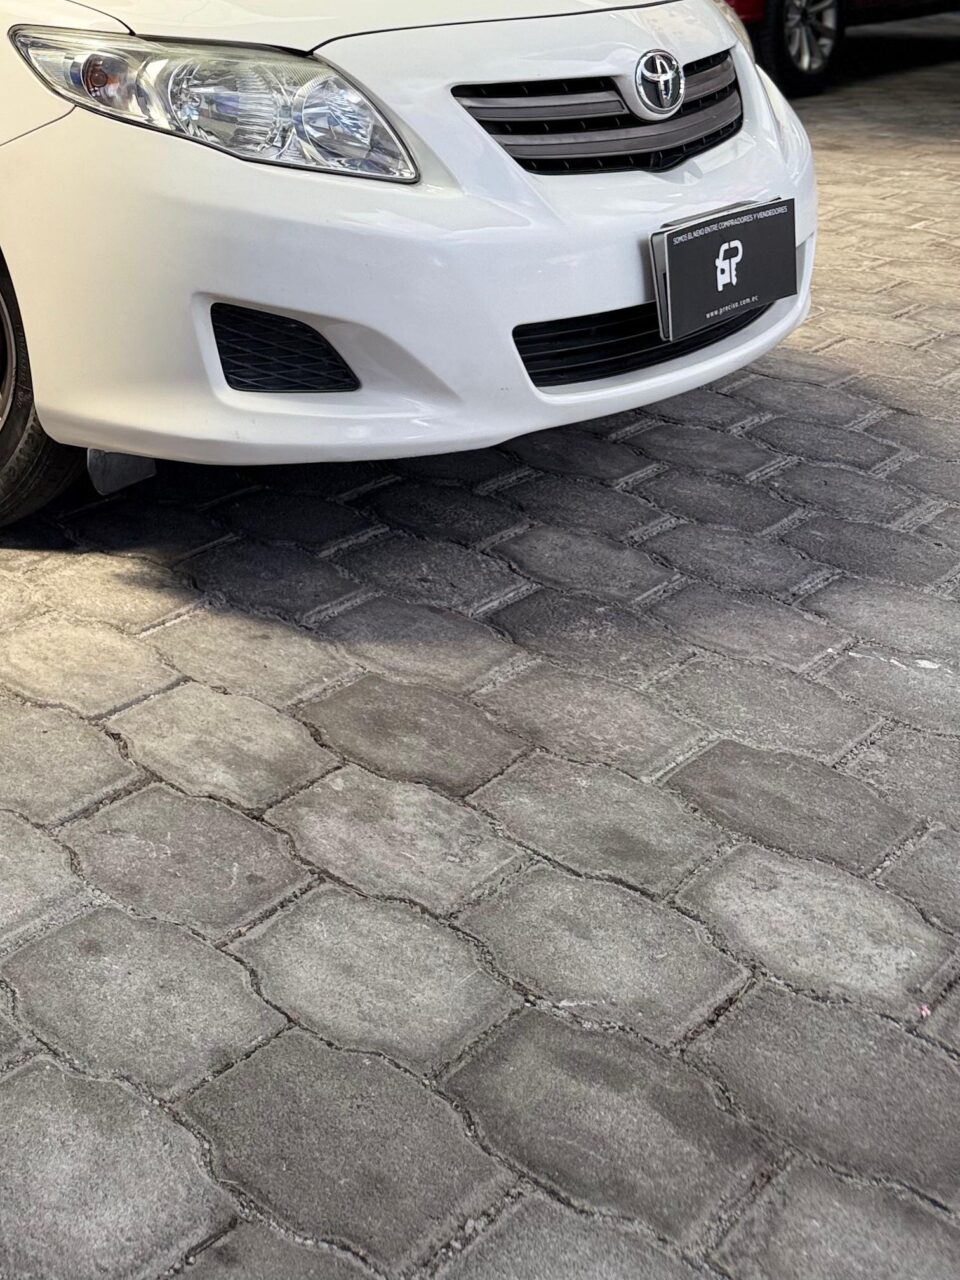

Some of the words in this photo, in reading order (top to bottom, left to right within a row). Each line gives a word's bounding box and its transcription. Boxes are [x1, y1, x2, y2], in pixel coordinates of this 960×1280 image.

[705, 223, 718, 234] ENTRE
[718, 214, 753, 230] COMPRADORES
[757, 205, 788, 219] VENDEDORES
